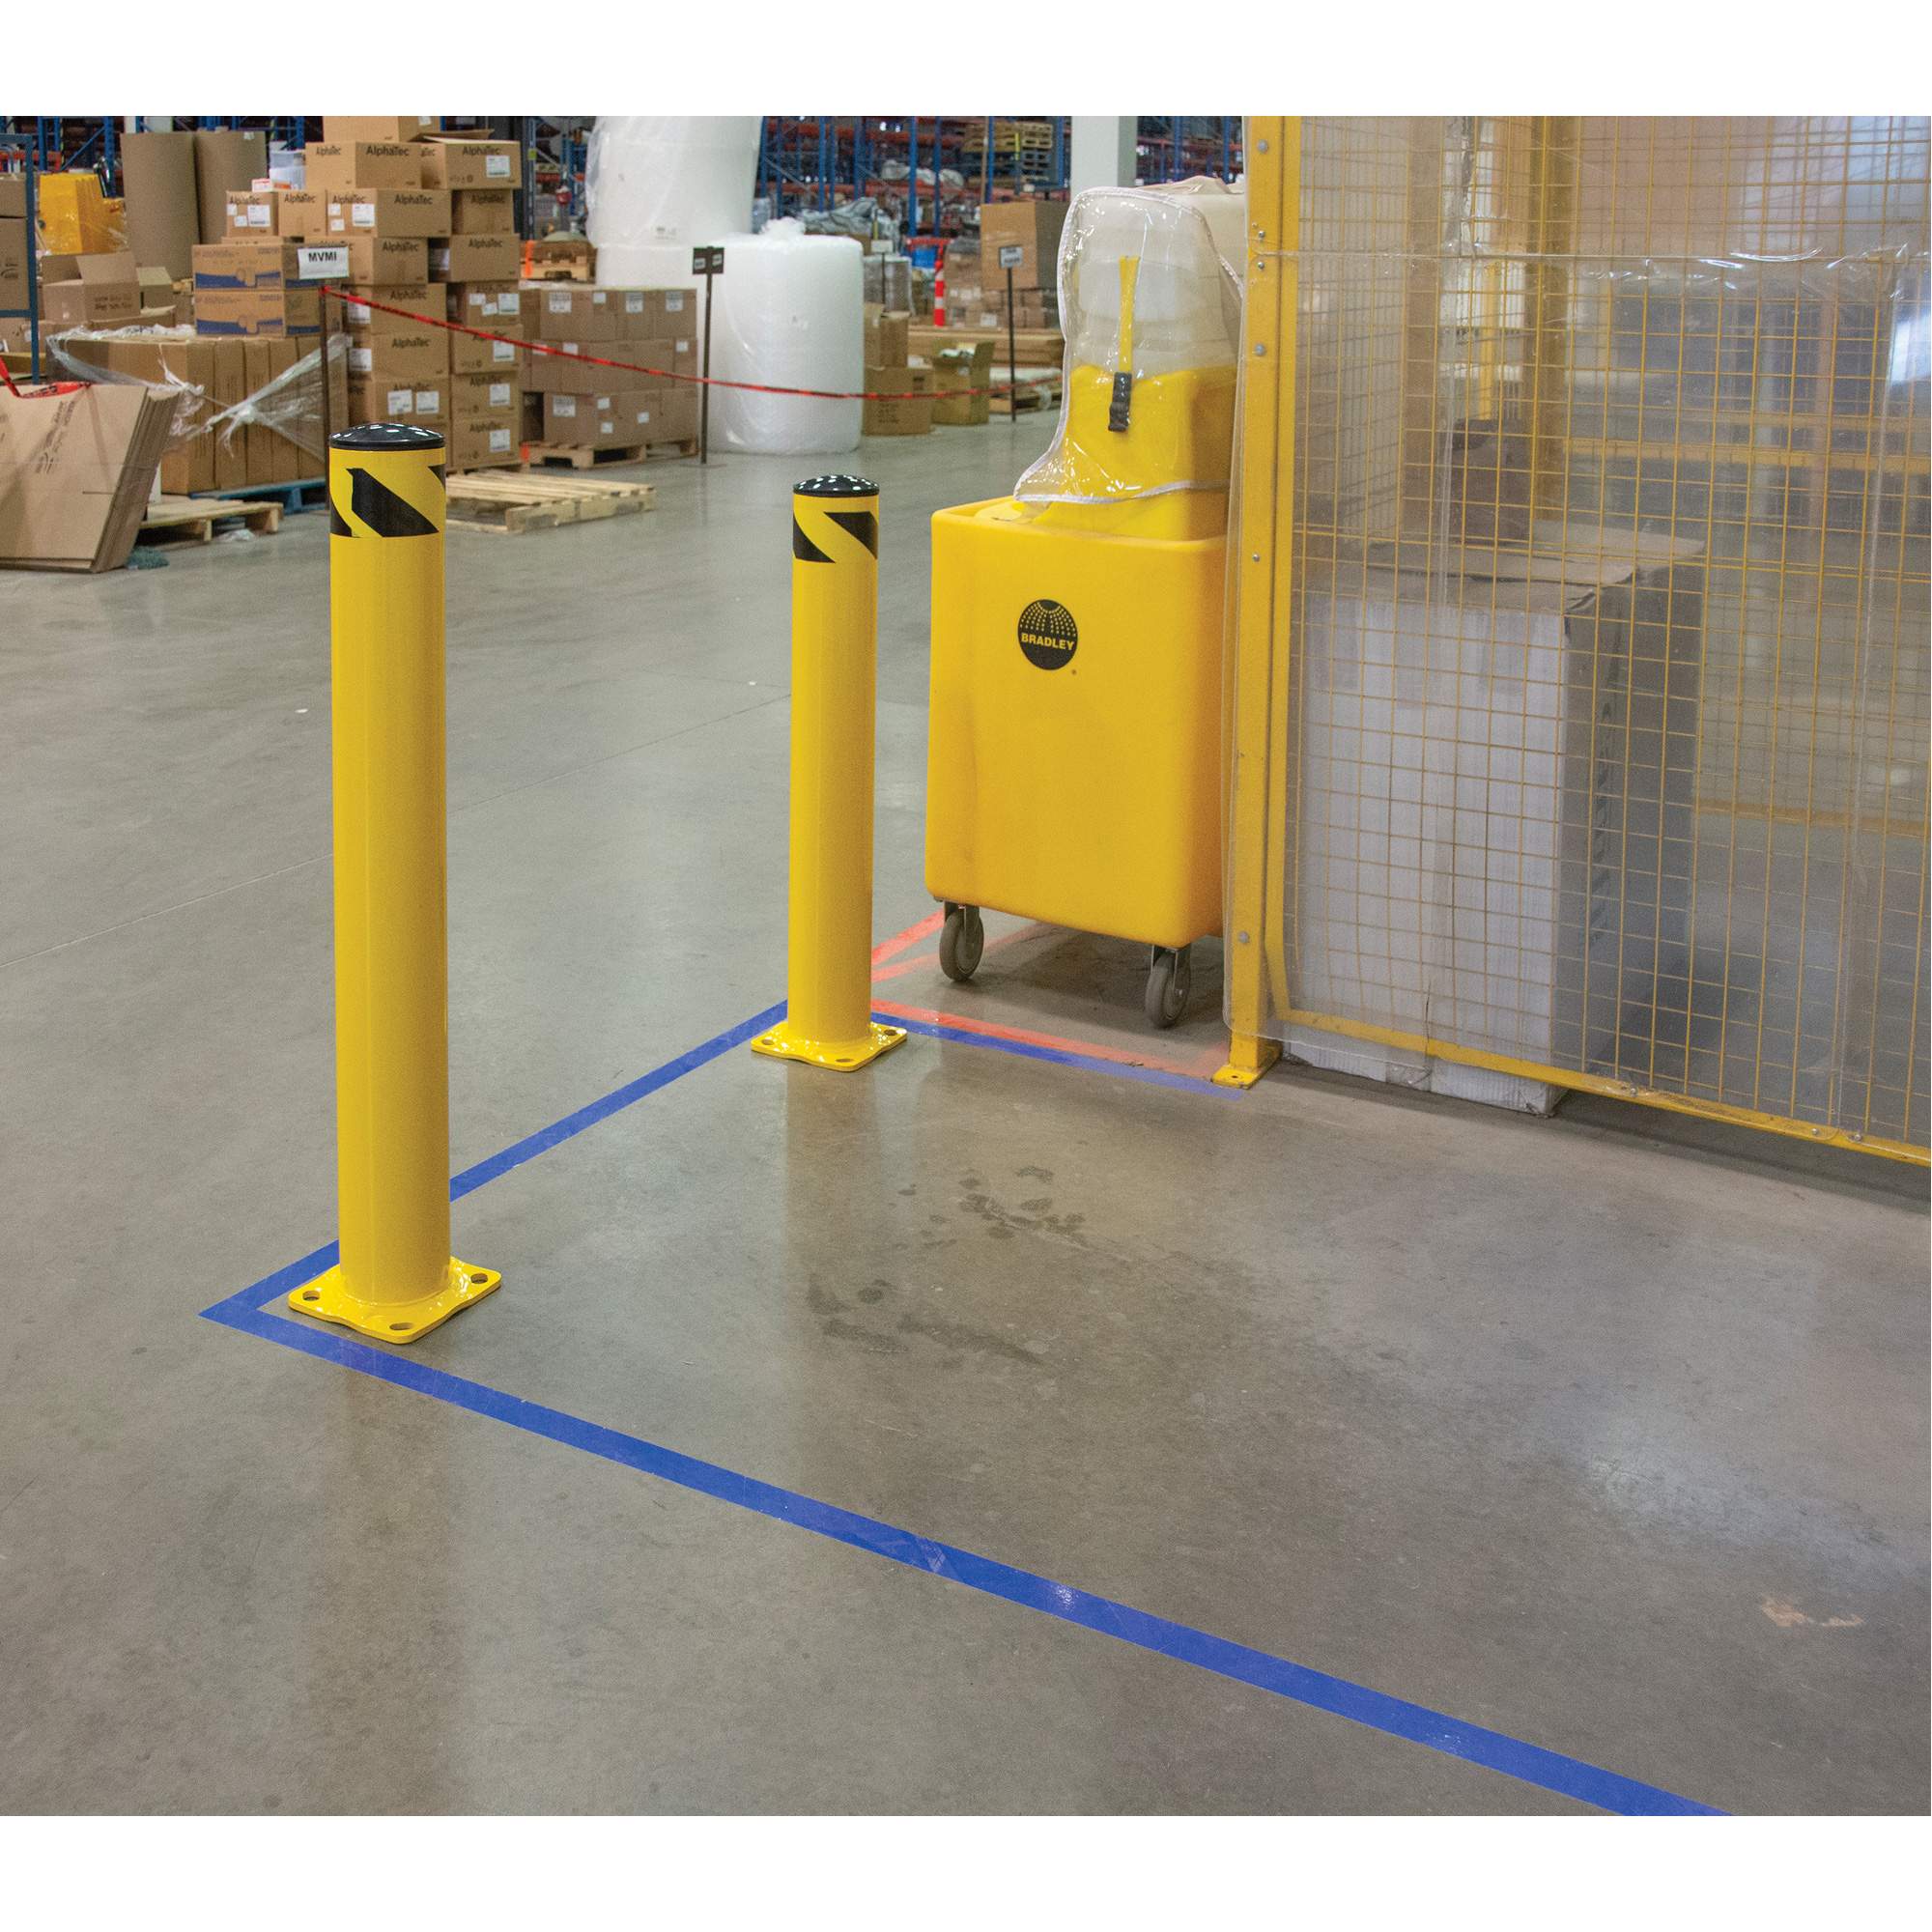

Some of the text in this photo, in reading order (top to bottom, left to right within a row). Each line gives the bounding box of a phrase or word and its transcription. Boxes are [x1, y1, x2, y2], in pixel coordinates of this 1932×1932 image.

[366, 146, 410, 156] AlphaTec
[462, 146, 502, 156] AlphaTec
[283, 194, 317, 204] AlphaTec
[332, 194, 366, 205] AlphaTec
[394, 194, 433, 205] AlphaTec
[383, 241, 418, 252] AlphaTec
[469, 238, 502, 248] AlphaTec
[308, 251, 337, 263] MVMI
[391, 337, 430, 348] AlphaTec
[1021, 633, 1074, 650] BRADLEY
